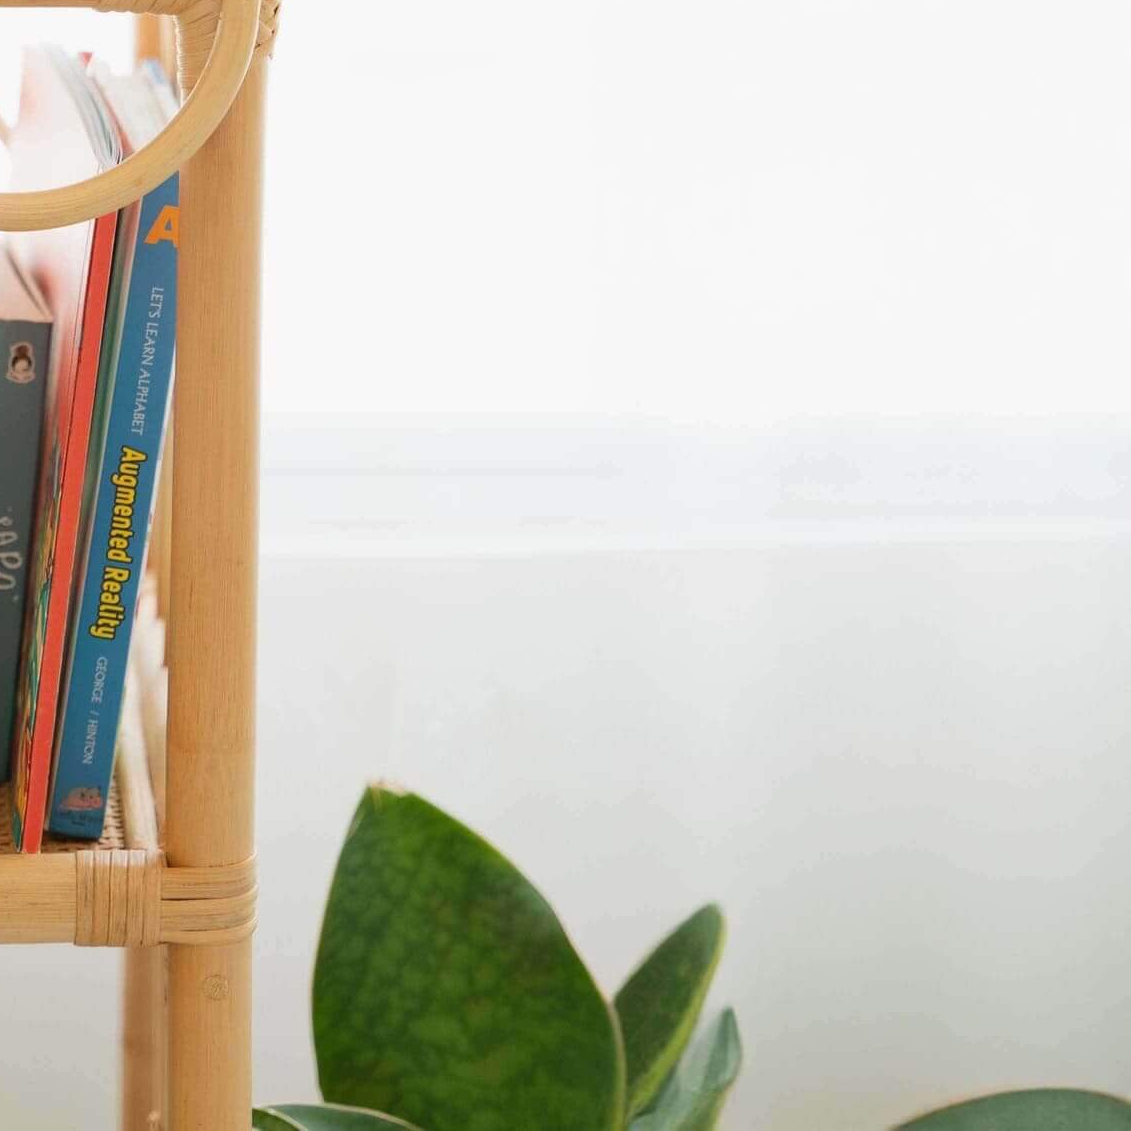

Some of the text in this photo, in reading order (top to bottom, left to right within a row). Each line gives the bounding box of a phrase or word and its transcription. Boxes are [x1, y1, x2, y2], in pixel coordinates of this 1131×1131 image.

[140, 322, 159, 366] LEARN
[131, 368, 152, 436] ALPHABET
[89, 445, 147, 640] Augmented Reality
[91, 656, 108, 704] GEORGE
[82, 719, 98, 765] HINTON
